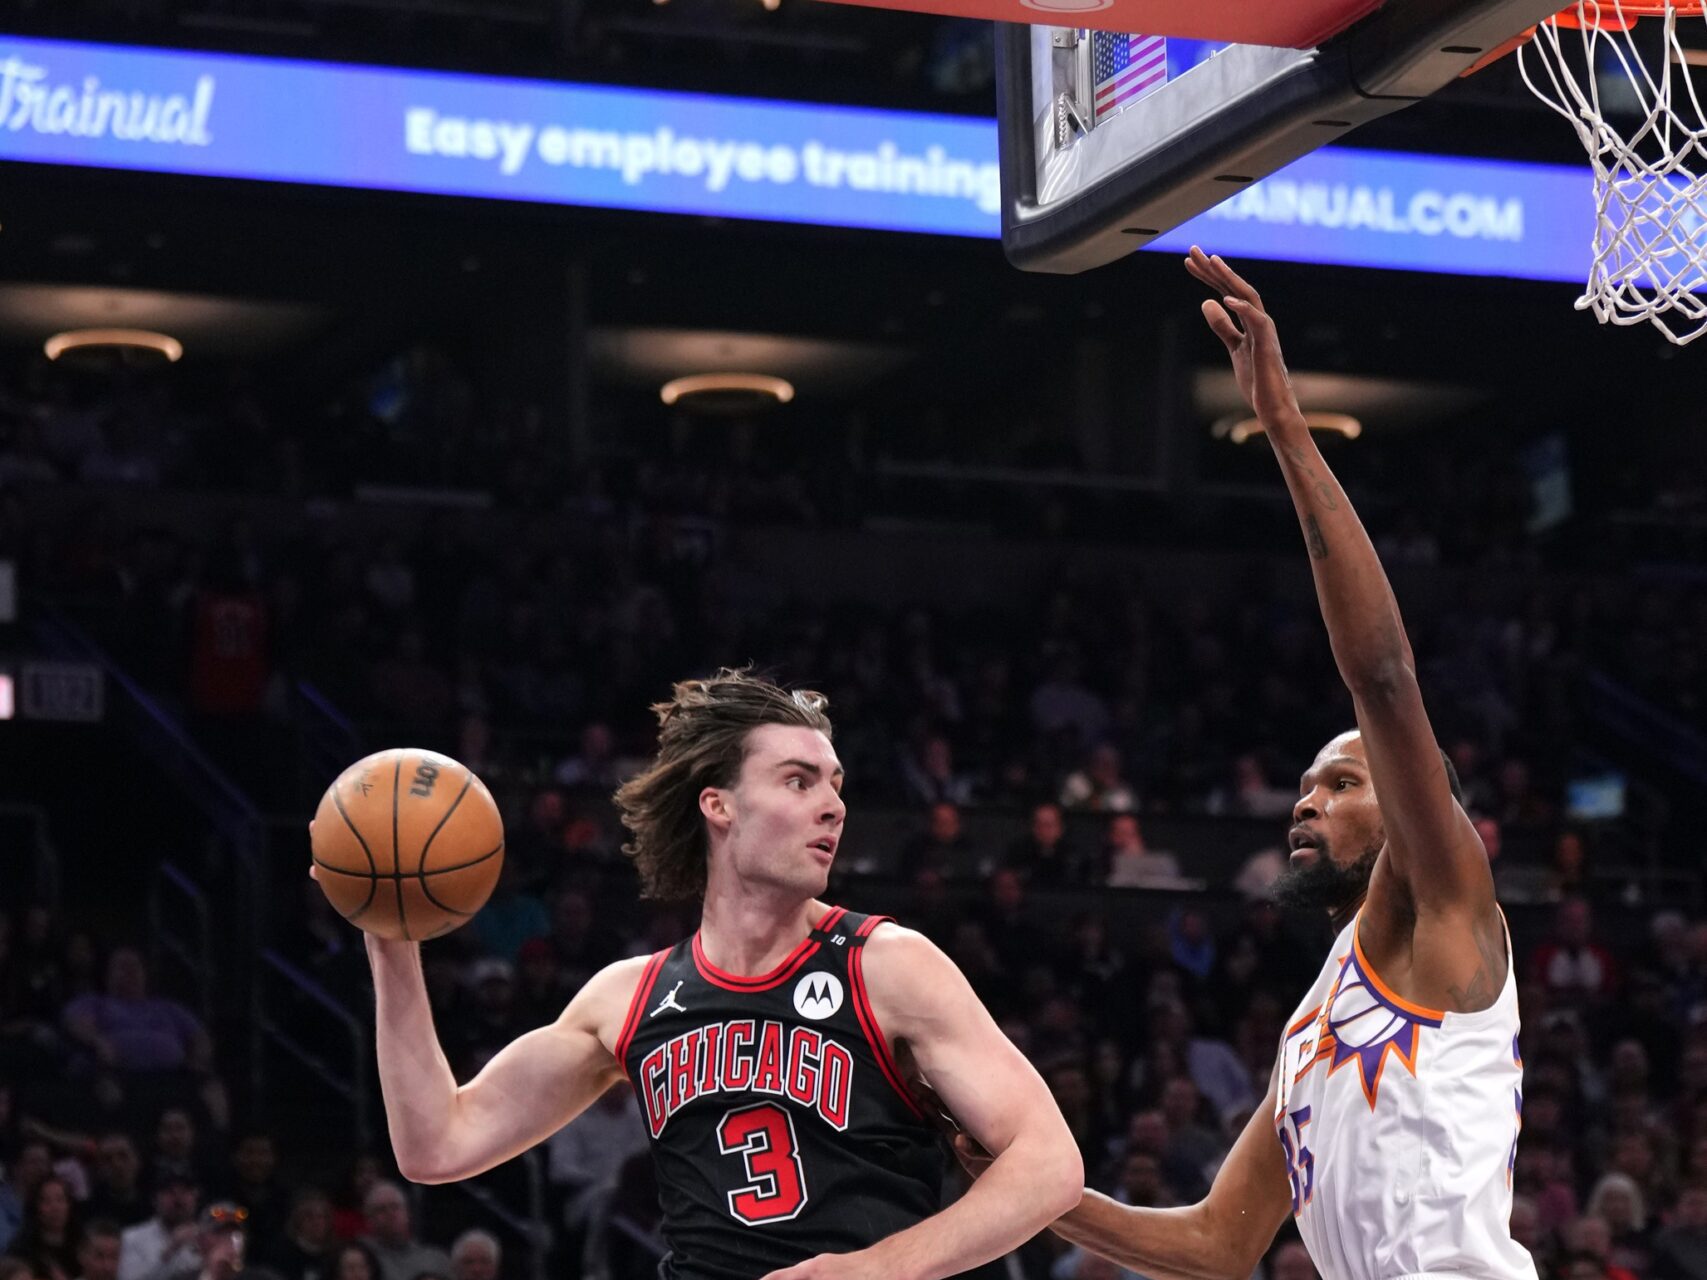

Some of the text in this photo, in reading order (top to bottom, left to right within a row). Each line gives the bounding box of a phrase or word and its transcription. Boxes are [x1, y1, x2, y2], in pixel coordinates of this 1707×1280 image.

[0, 57, 215, 146] Trainual
[405, 107, 533, 175] Easy
[536, 127, 798, 193] employee
[830, 934, 846, 946] 10
[640, 1019, 854, 1140] CHICAGO
[716, 1100, 809, 1226] 3
